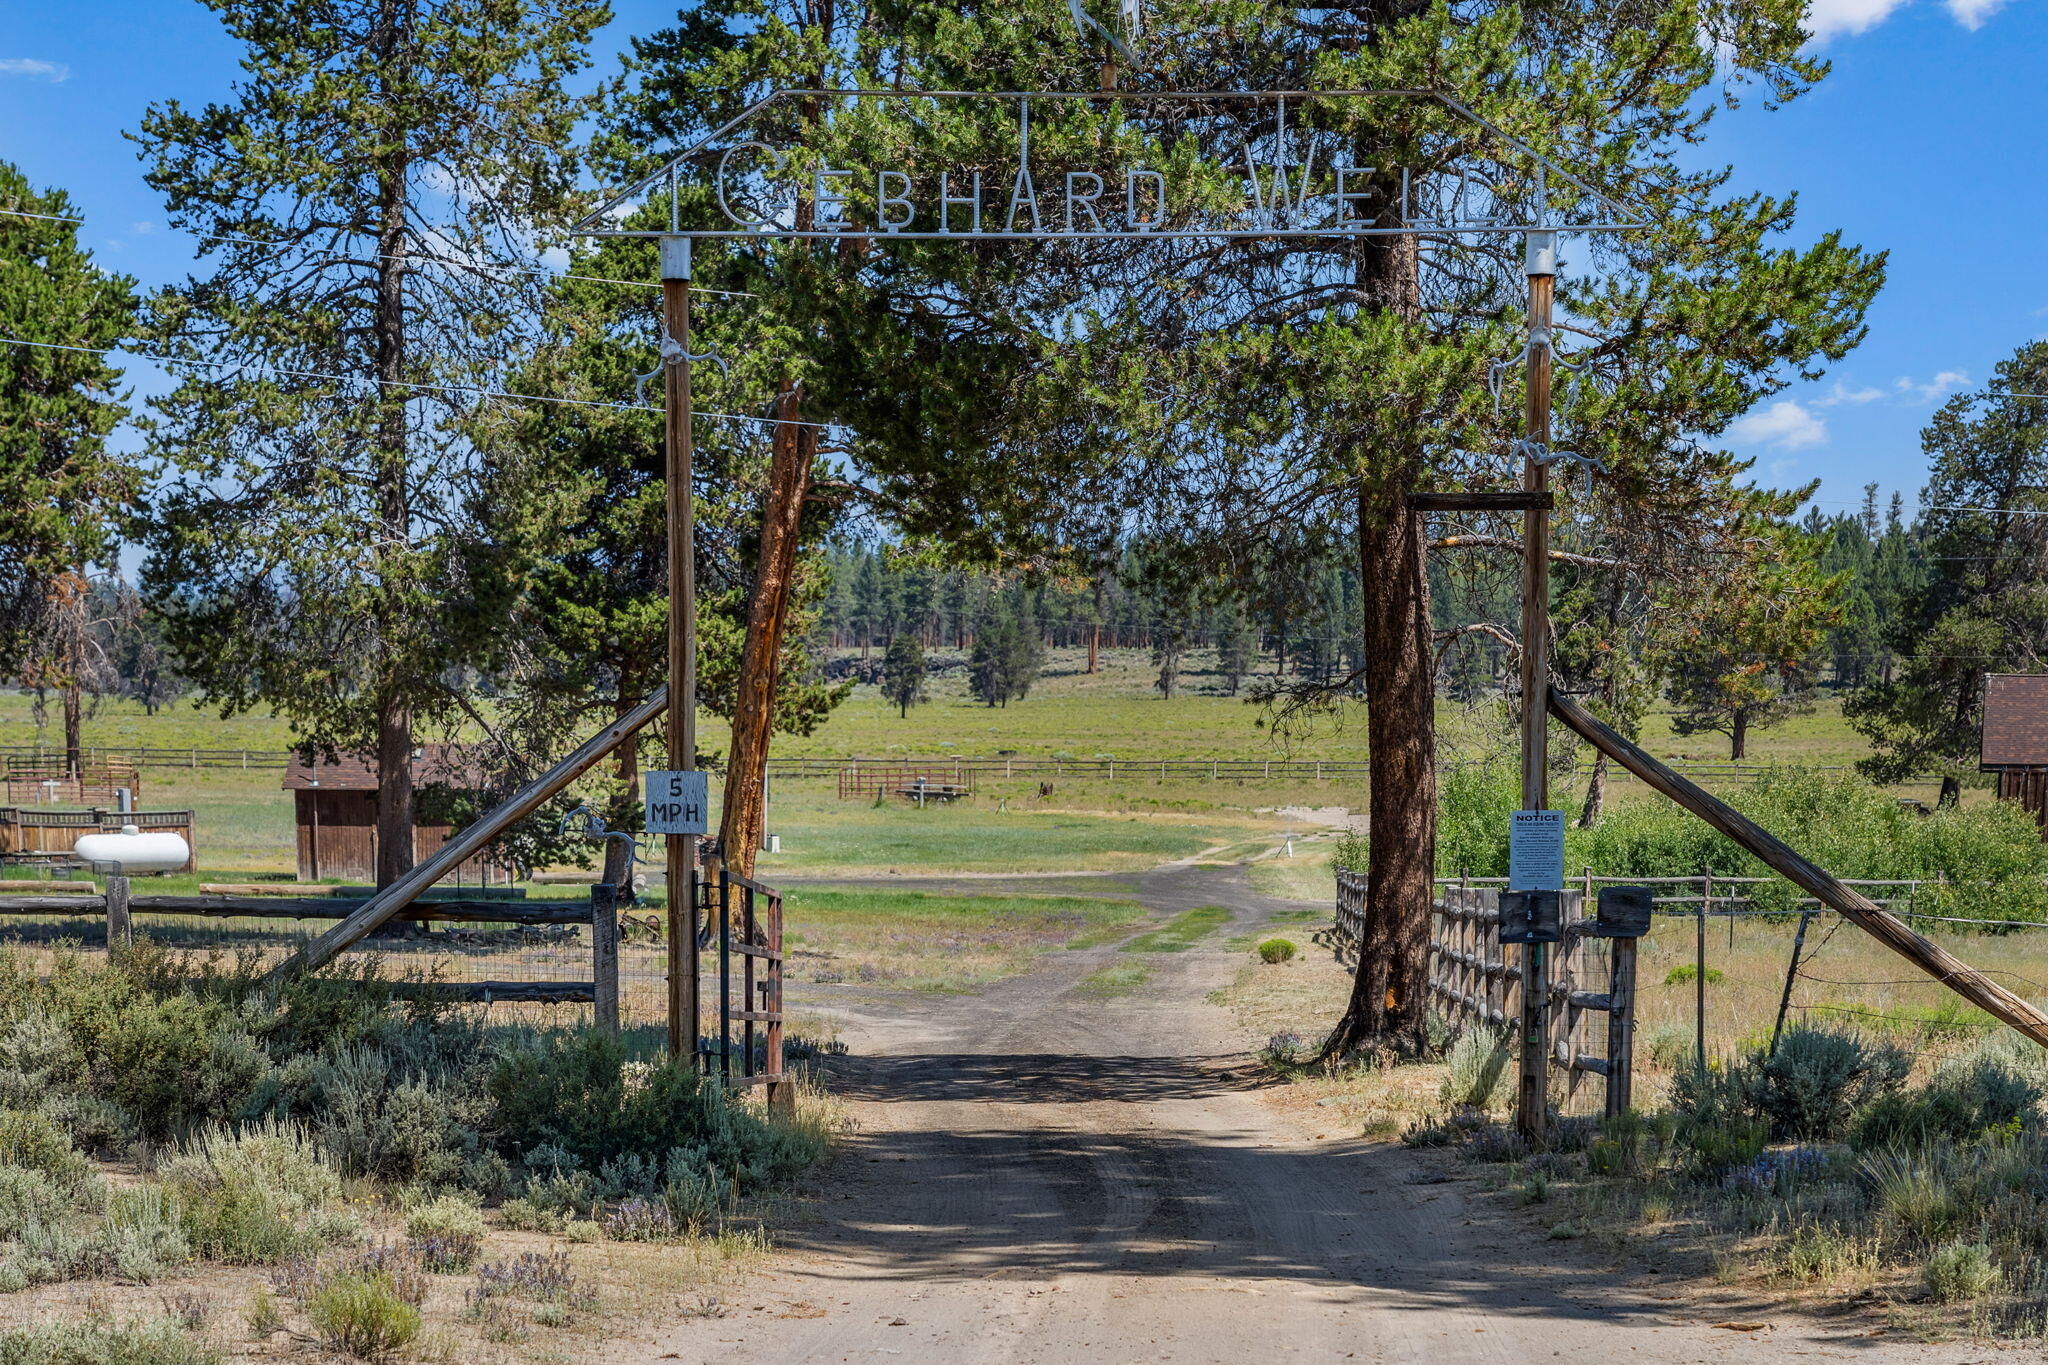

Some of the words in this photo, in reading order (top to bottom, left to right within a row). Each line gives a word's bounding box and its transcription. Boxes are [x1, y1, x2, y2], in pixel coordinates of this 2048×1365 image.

[716, 141, 1166, 232] GEBHARD
[1243, 140, 1499, 230] WELL
[670, 777, 683, 797] 5
[651, 803, 699, 822] MPH
